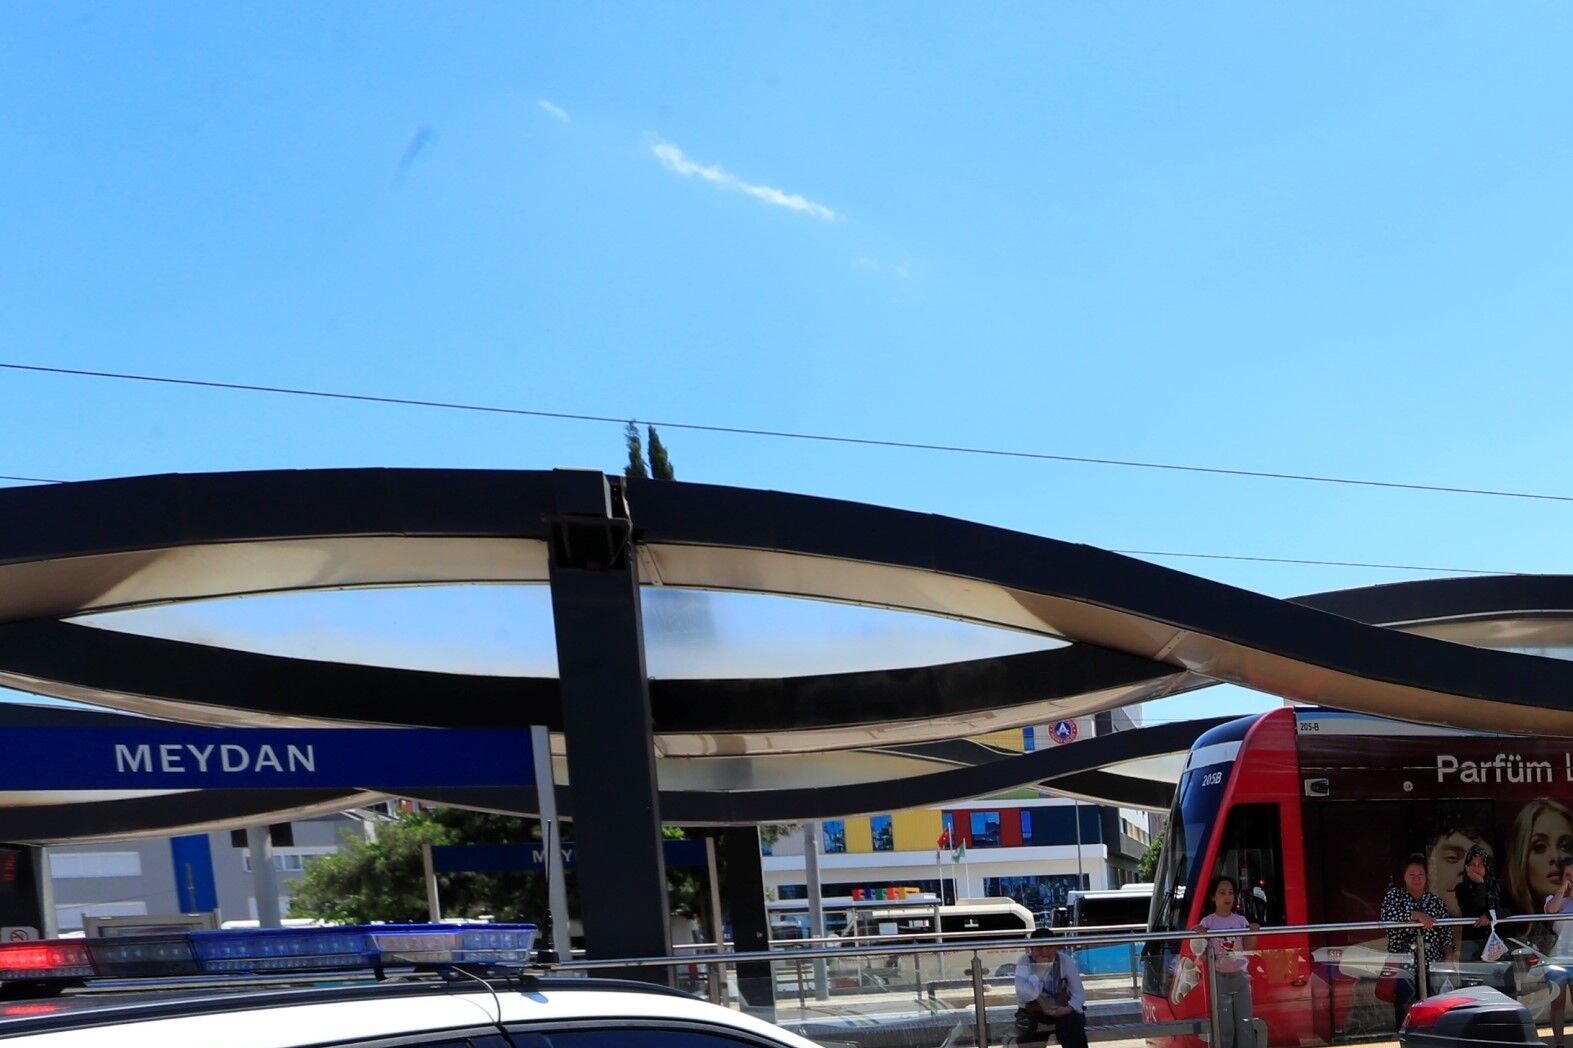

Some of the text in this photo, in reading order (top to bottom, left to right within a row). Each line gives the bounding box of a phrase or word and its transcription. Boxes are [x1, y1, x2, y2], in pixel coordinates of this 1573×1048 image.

[1300, 722, 1320, 731] 205-B
[115, 744, 315, 772] MEYDAN
[1437, 754, 1552, 783] Parfüm
[1202, 772, 1223, 786] 205B
